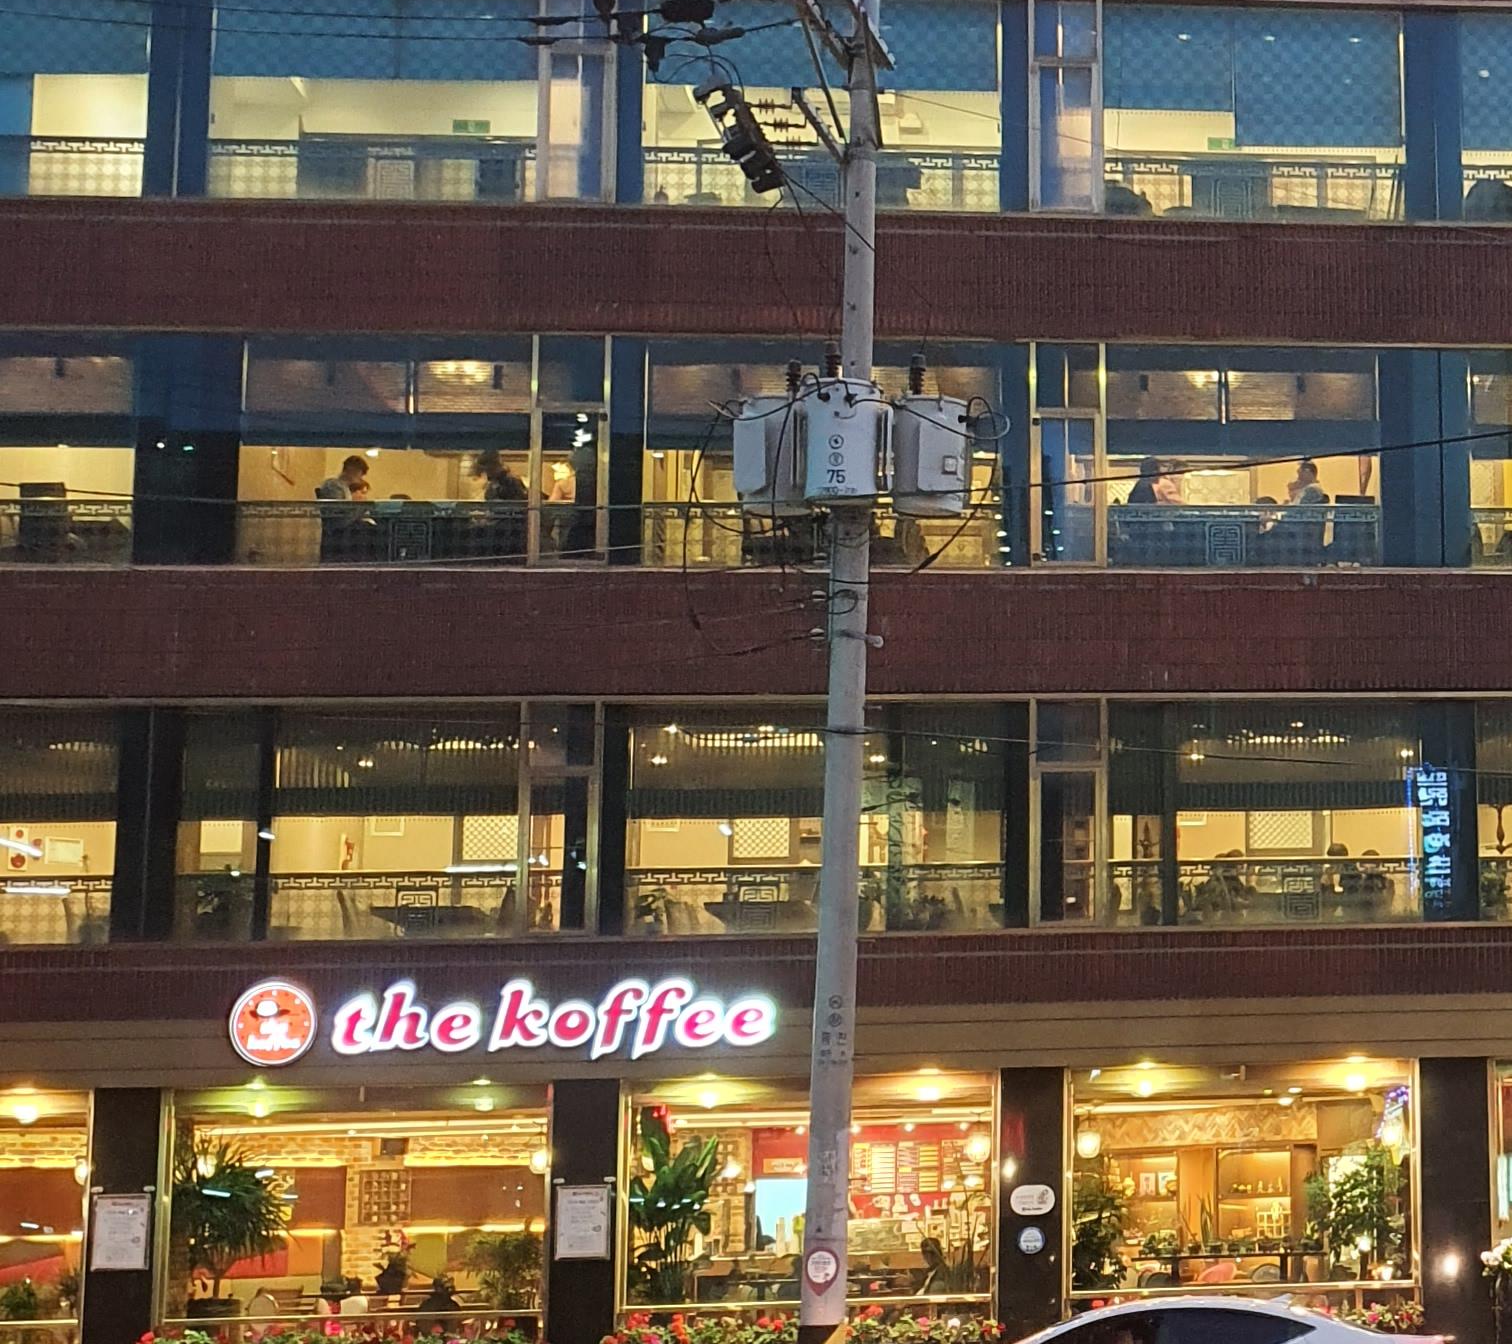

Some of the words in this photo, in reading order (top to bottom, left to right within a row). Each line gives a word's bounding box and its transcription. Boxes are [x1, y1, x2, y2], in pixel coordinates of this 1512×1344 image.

[826, 469, 846, 484] 75
[334, 981, 478, 1053] the
[491, 980, 773, 1058] koffee
